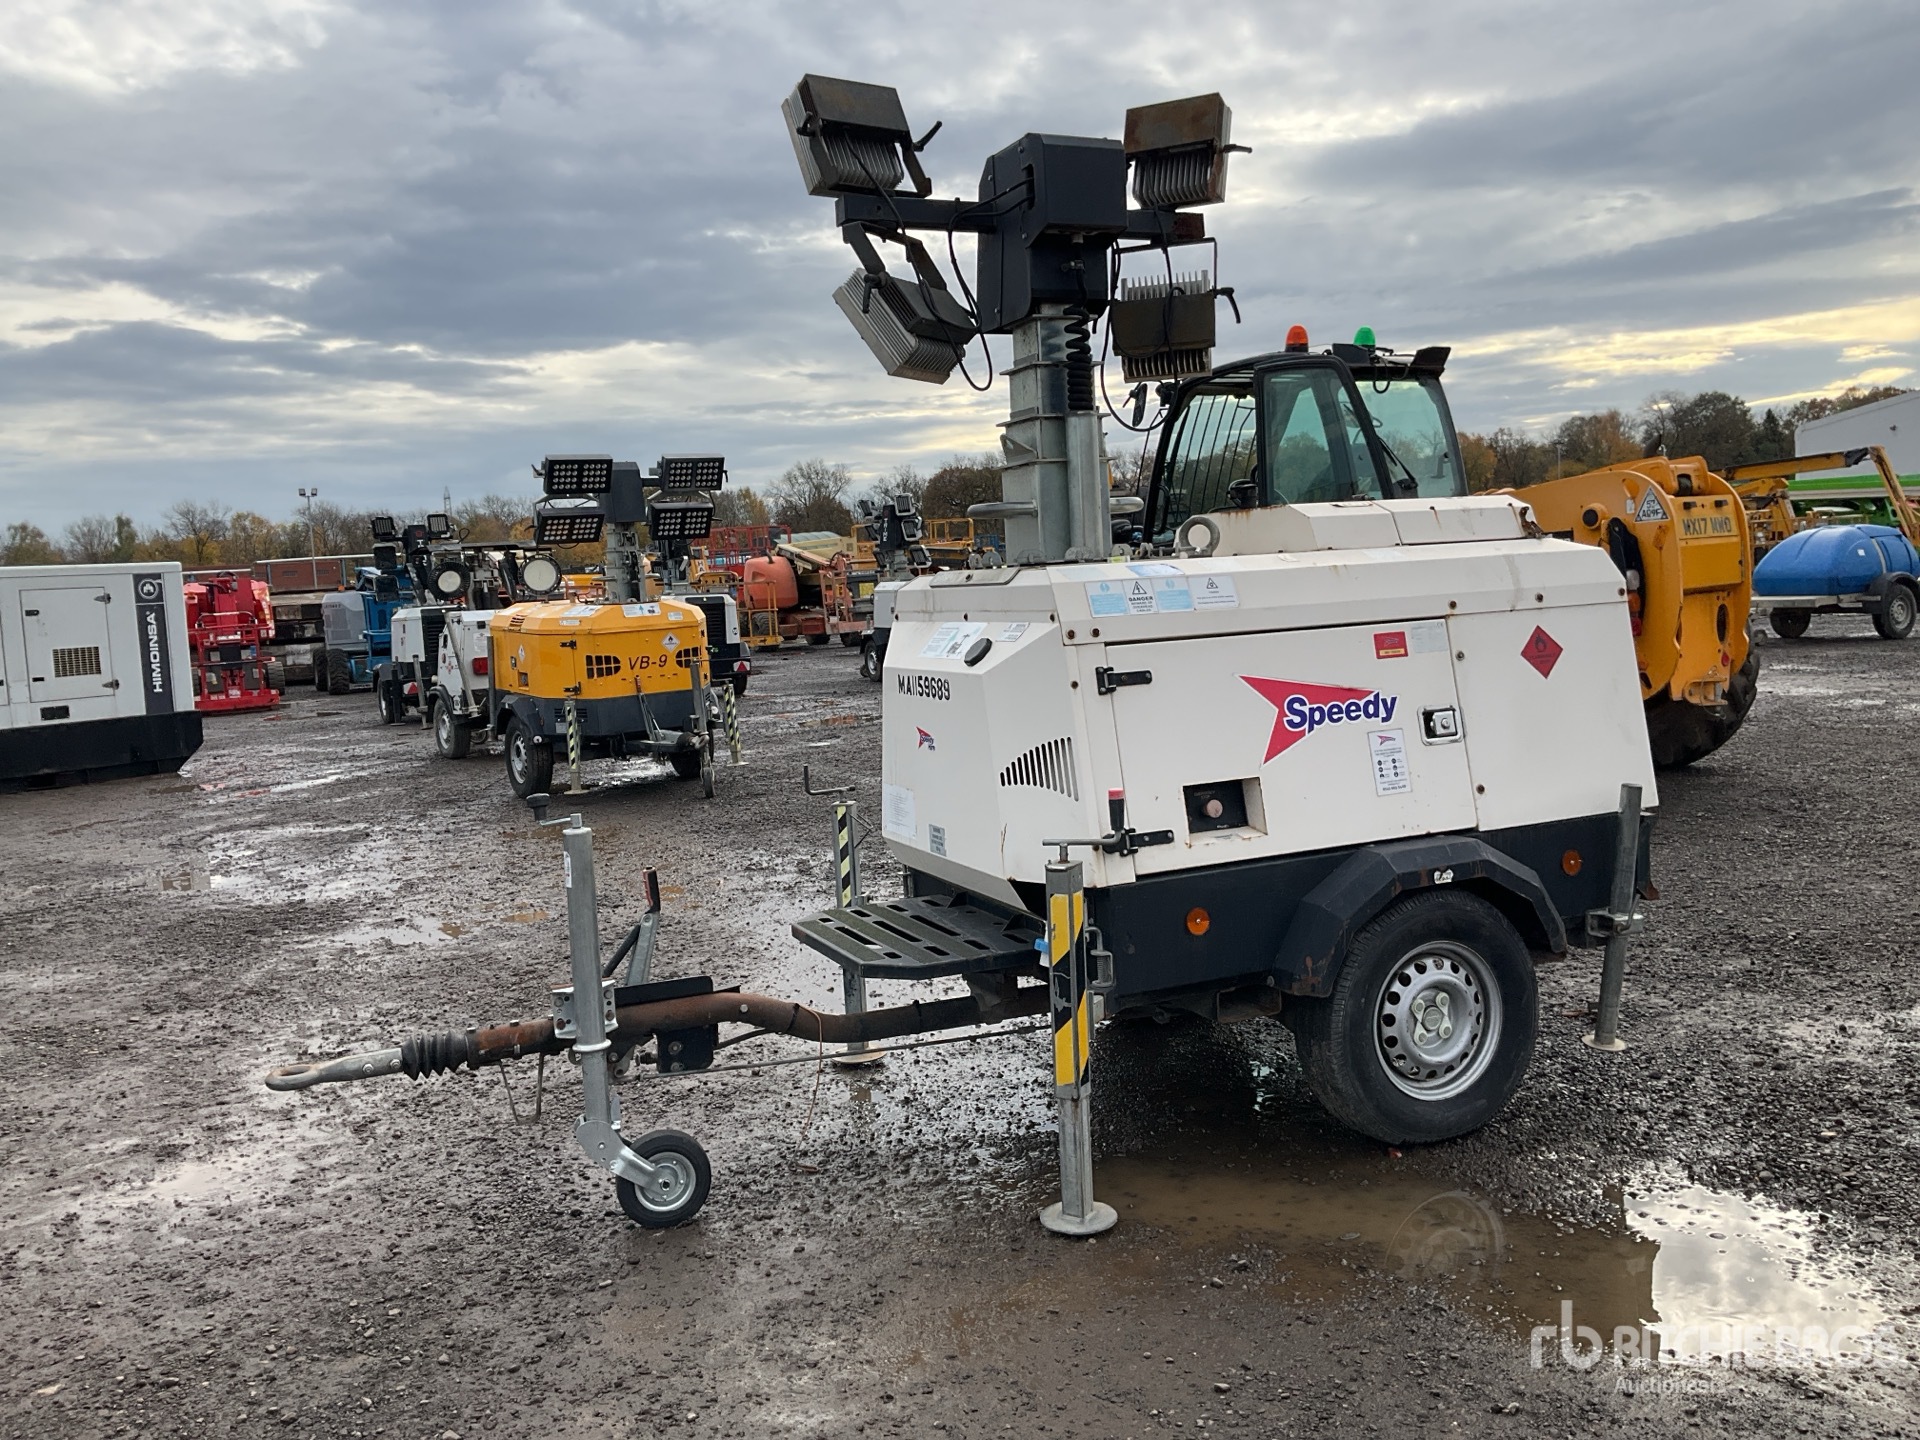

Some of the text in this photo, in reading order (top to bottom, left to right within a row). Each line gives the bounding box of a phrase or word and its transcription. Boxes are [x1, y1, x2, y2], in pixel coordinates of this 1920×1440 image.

[146, 612, 163, 693] HIMOINSA
[628, 654, 668, 670] VB-9
[1286, 691, 1398, 734] Speedy
